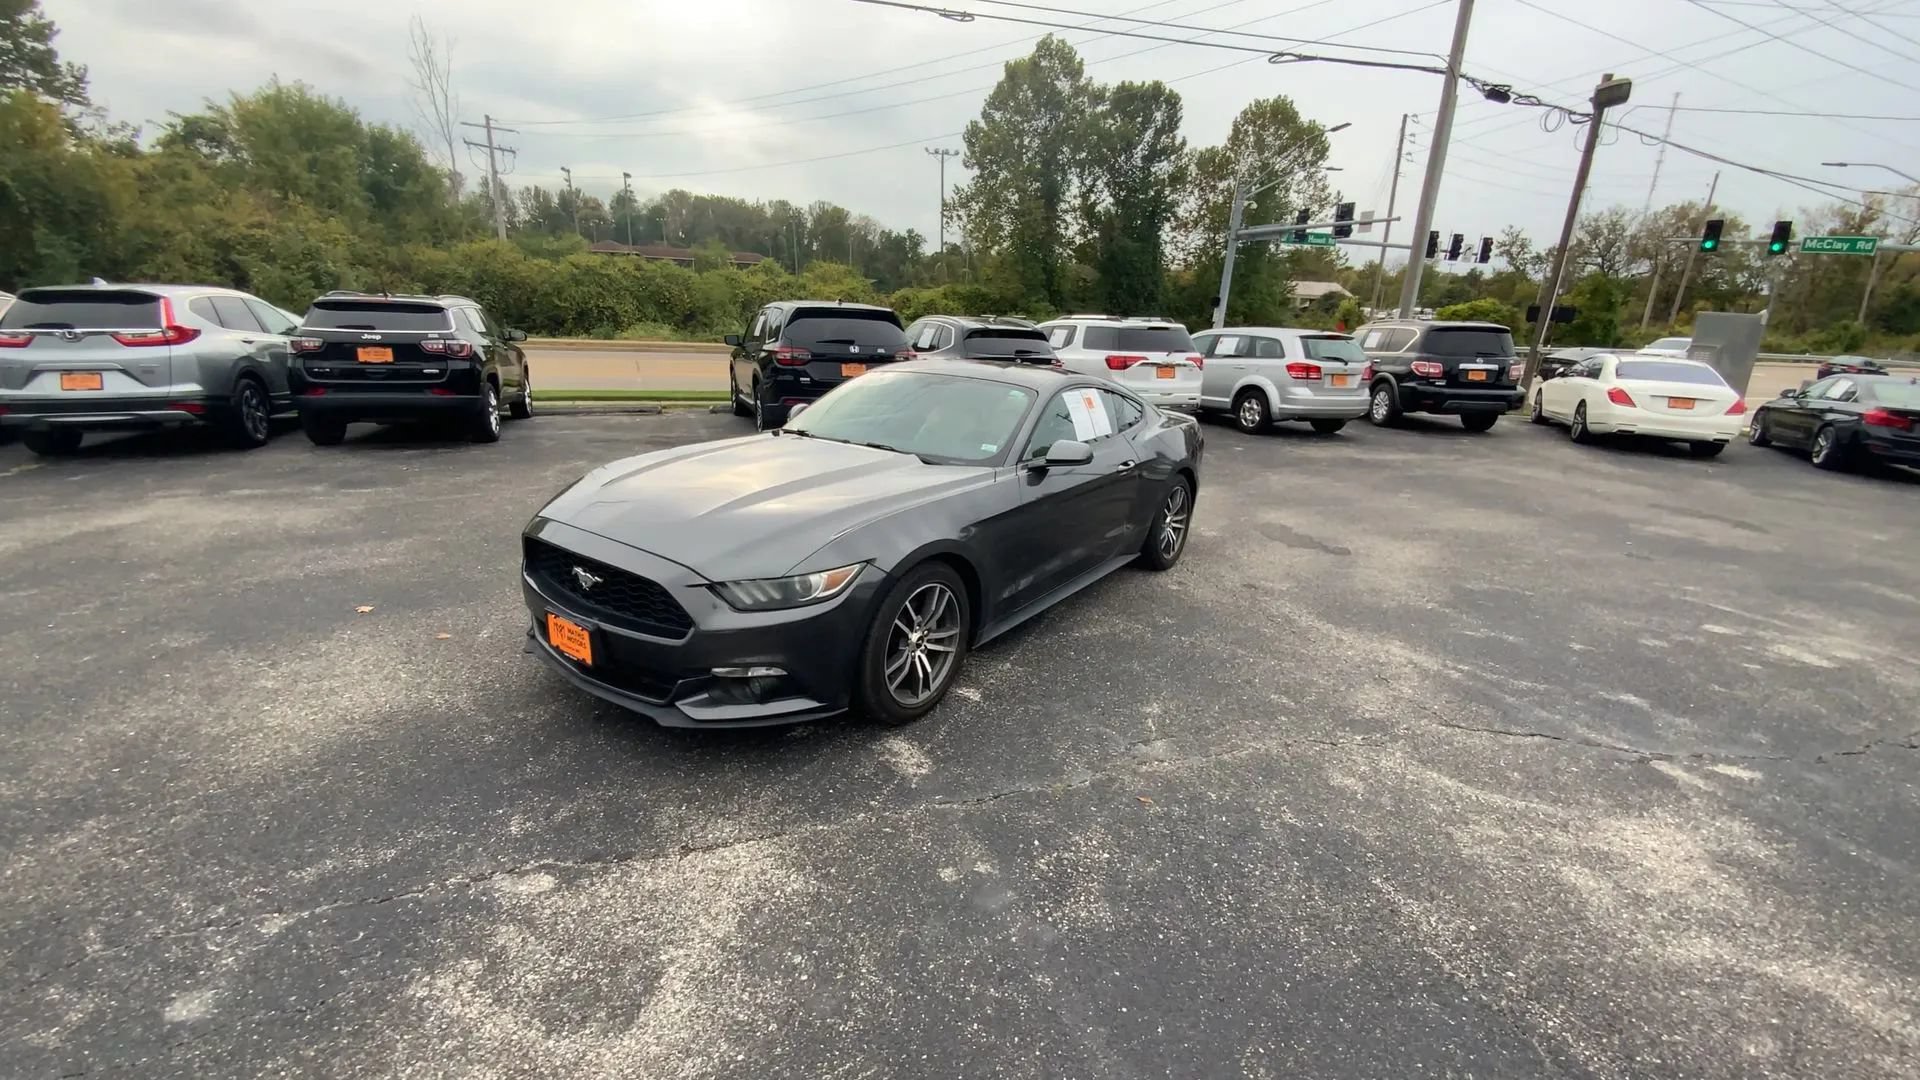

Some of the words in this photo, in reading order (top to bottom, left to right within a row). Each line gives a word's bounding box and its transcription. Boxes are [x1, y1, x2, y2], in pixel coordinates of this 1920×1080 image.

[1804, 239, 1850, 251] McClay
[1856, 240, 1873, 250] Rd
[360, 333, 382, 341] Jeep
